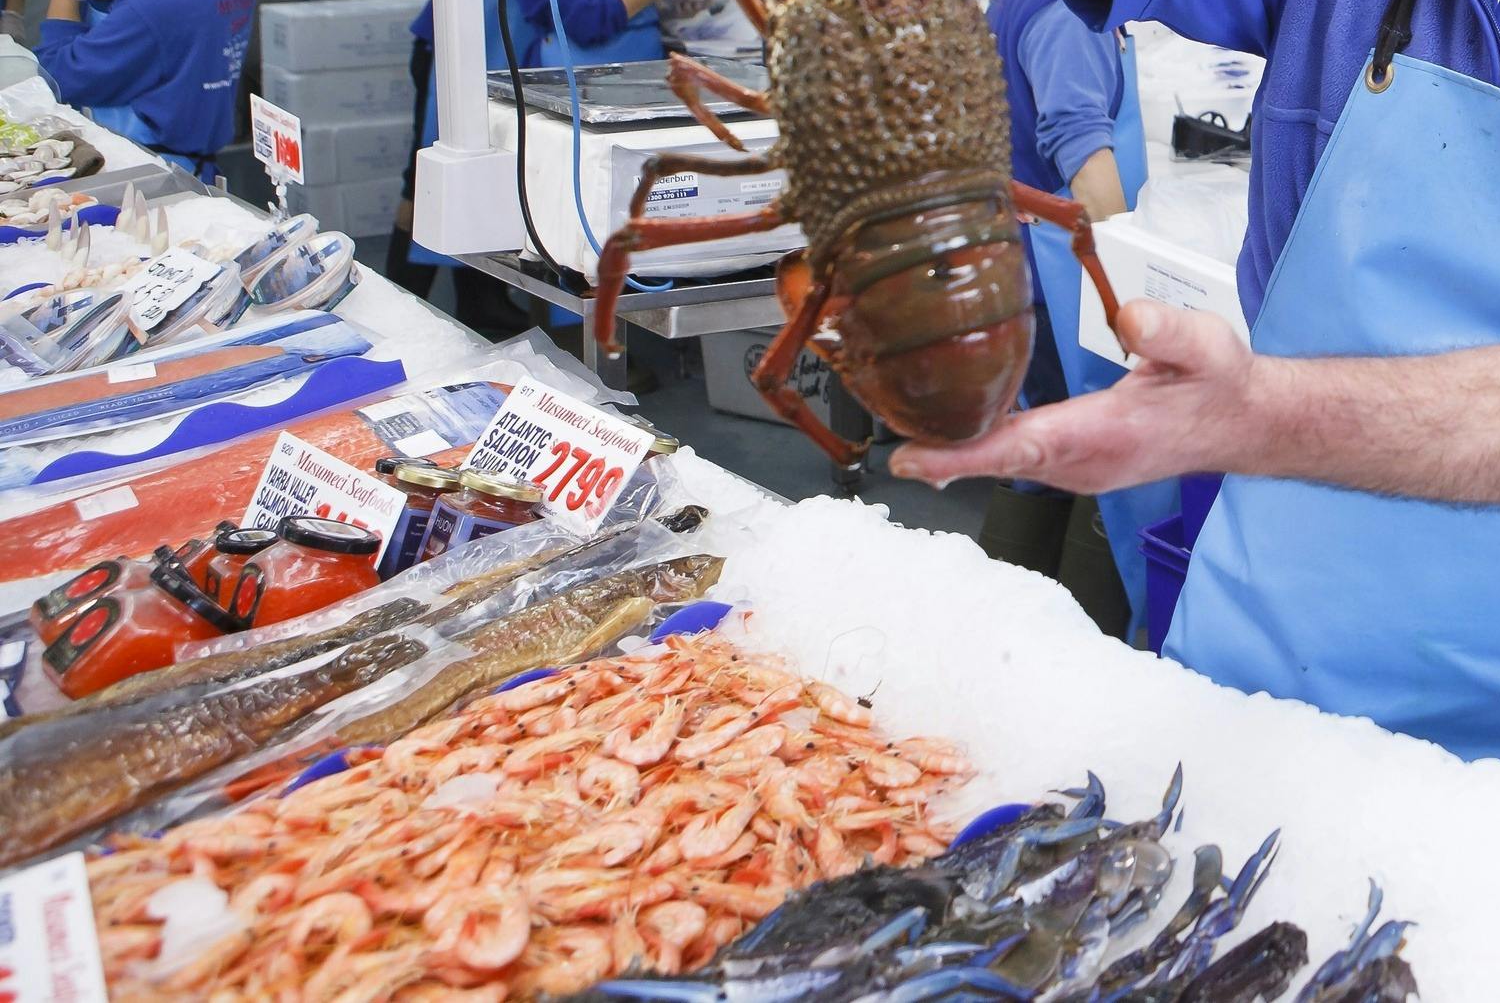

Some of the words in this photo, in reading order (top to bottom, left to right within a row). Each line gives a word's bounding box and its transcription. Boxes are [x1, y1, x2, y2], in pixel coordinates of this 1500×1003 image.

[663, 192, 675, 200] 970
[99, 399, 129, 411] READY
[148, 390, 175, 399] SERVE
[520, 385, 535, 398] 917
[496, 411, 553, 450] ATLANTIC
[532, 392, 595, 431] Musumeci
[588, 417, 642, 456] Seafoods
[281, 442, 294, 456] 920
[484, 428, 541, 470] SALMON
[266, 464, 291, 494] YARRA
[288, 475, 318, 506] VALLEY
[293, 450, 352, 491] Musumeci
[346, 476, 396, 516] Seafoods
[256, 485, 289, 516] SALMON
[435, 515, 455, 534] HUON
